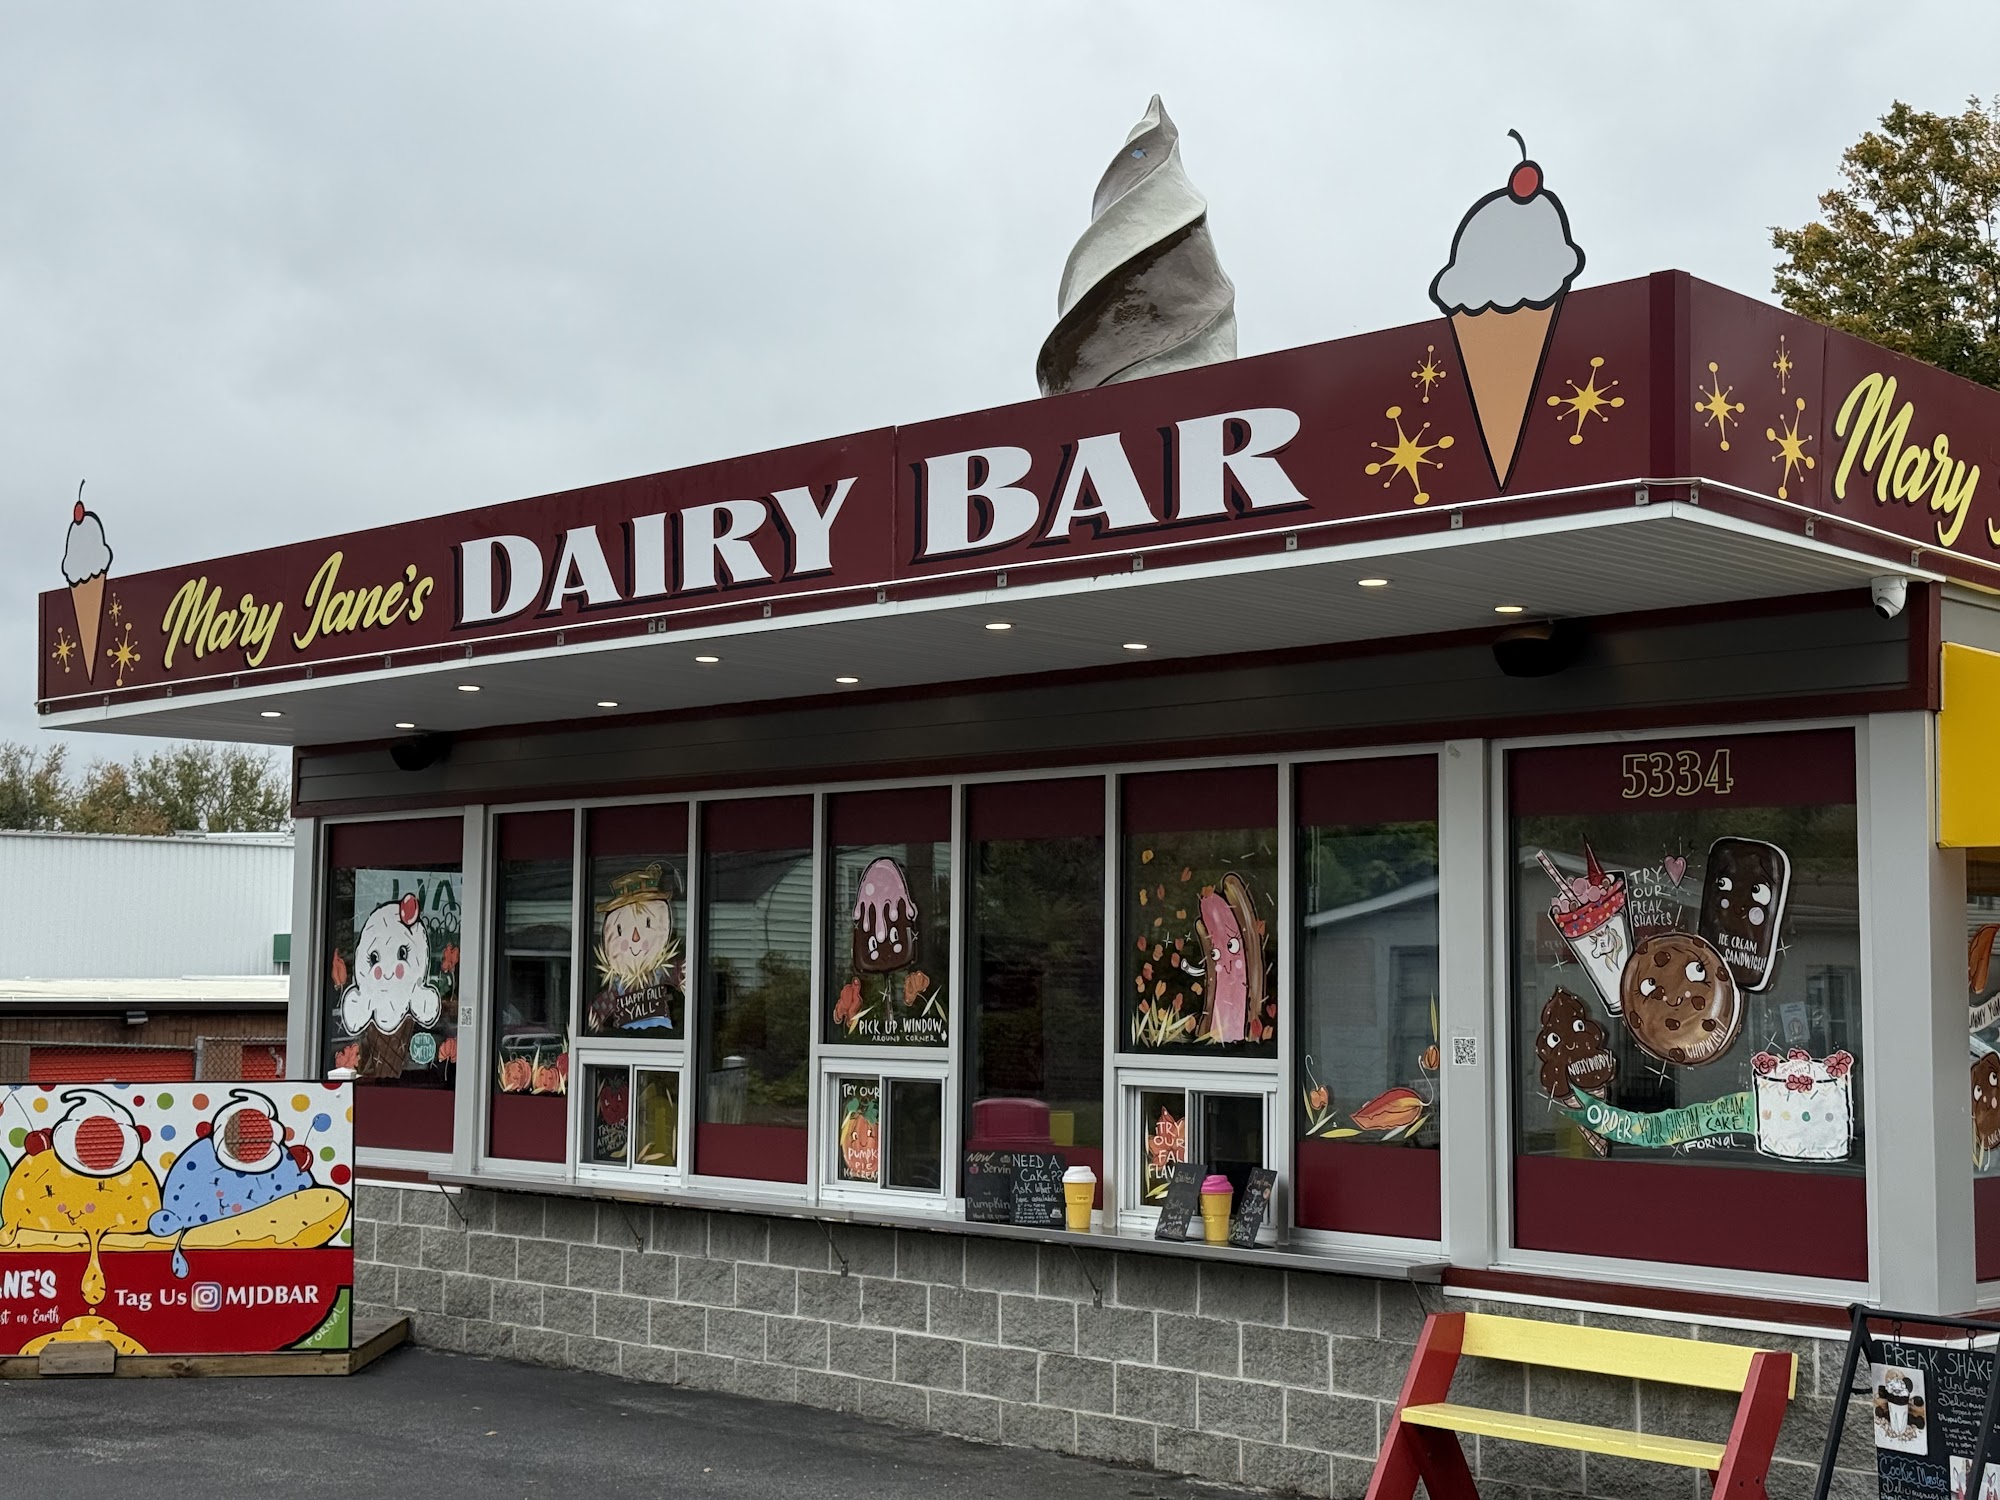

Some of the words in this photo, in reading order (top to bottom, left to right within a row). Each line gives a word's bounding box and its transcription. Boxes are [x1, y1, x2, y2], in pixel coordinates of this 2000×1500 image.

[1834, 372, 1980, 547] Mary
[162, 576, 283, 668] Mary
[293, 551, 434, 650] Jane's
[459, 476, 859, 625] DAIRY
[923, 407, 1311, 557] BAR
[1622, 749, 1734, 798] 5334
[1629, 865, 1663, 884] TRY
[1633, 885, 1671, 898] OUR
[1631, 899, 1663, 916] FREAK
[1718, 933, 1730, 946] ICE
[1731, 936, 1757, 954] CREAM
[620, 990, 645, 1008] HAPPY
[646, 986, 662, 1000] FALL
[625, 1002, 656, 1020] Y'ALL
[859, 1019, 881, 1035] PICK
[885, 1020, 898, 1034] UP
[903, 1017, 942, 1034] WINDOW
[872, 1034, 900, 1042] AROUND
[905, 1034, 937, 1042] CORNER
[842, 1083, 857, 1098] TRY
[860, 1086, 880, 1099] OUR
[1716, 1096, 1745, 1116] CREAM
[1156, 1120, 1184, 1137] TRY
[1587, 1105, 1632, 1139] ORDER
[1637, 1116, 1665, 1144] YOUR
[1153, 1136, 1185, 1149] OUR
[855, 1162, 873, 1170] PIE
[1012, 1154, 1044, 1168] NEED
[1049, 1155, 1060, 1169] A
[1149, 1163, 1176, 1179] FLAV
[0, 1268, 57, 1299] NE'S
[114, 1289, 152, 1311] Tag
[160, 1288, 187, 1306] Us
[226, 1285, 319, 1309] MJDBAR
[16, 1314, 28, 1324] on
[32, 1305, 60, 1324] Earth
[1882, 1342, 1940, 1373] FREAK
